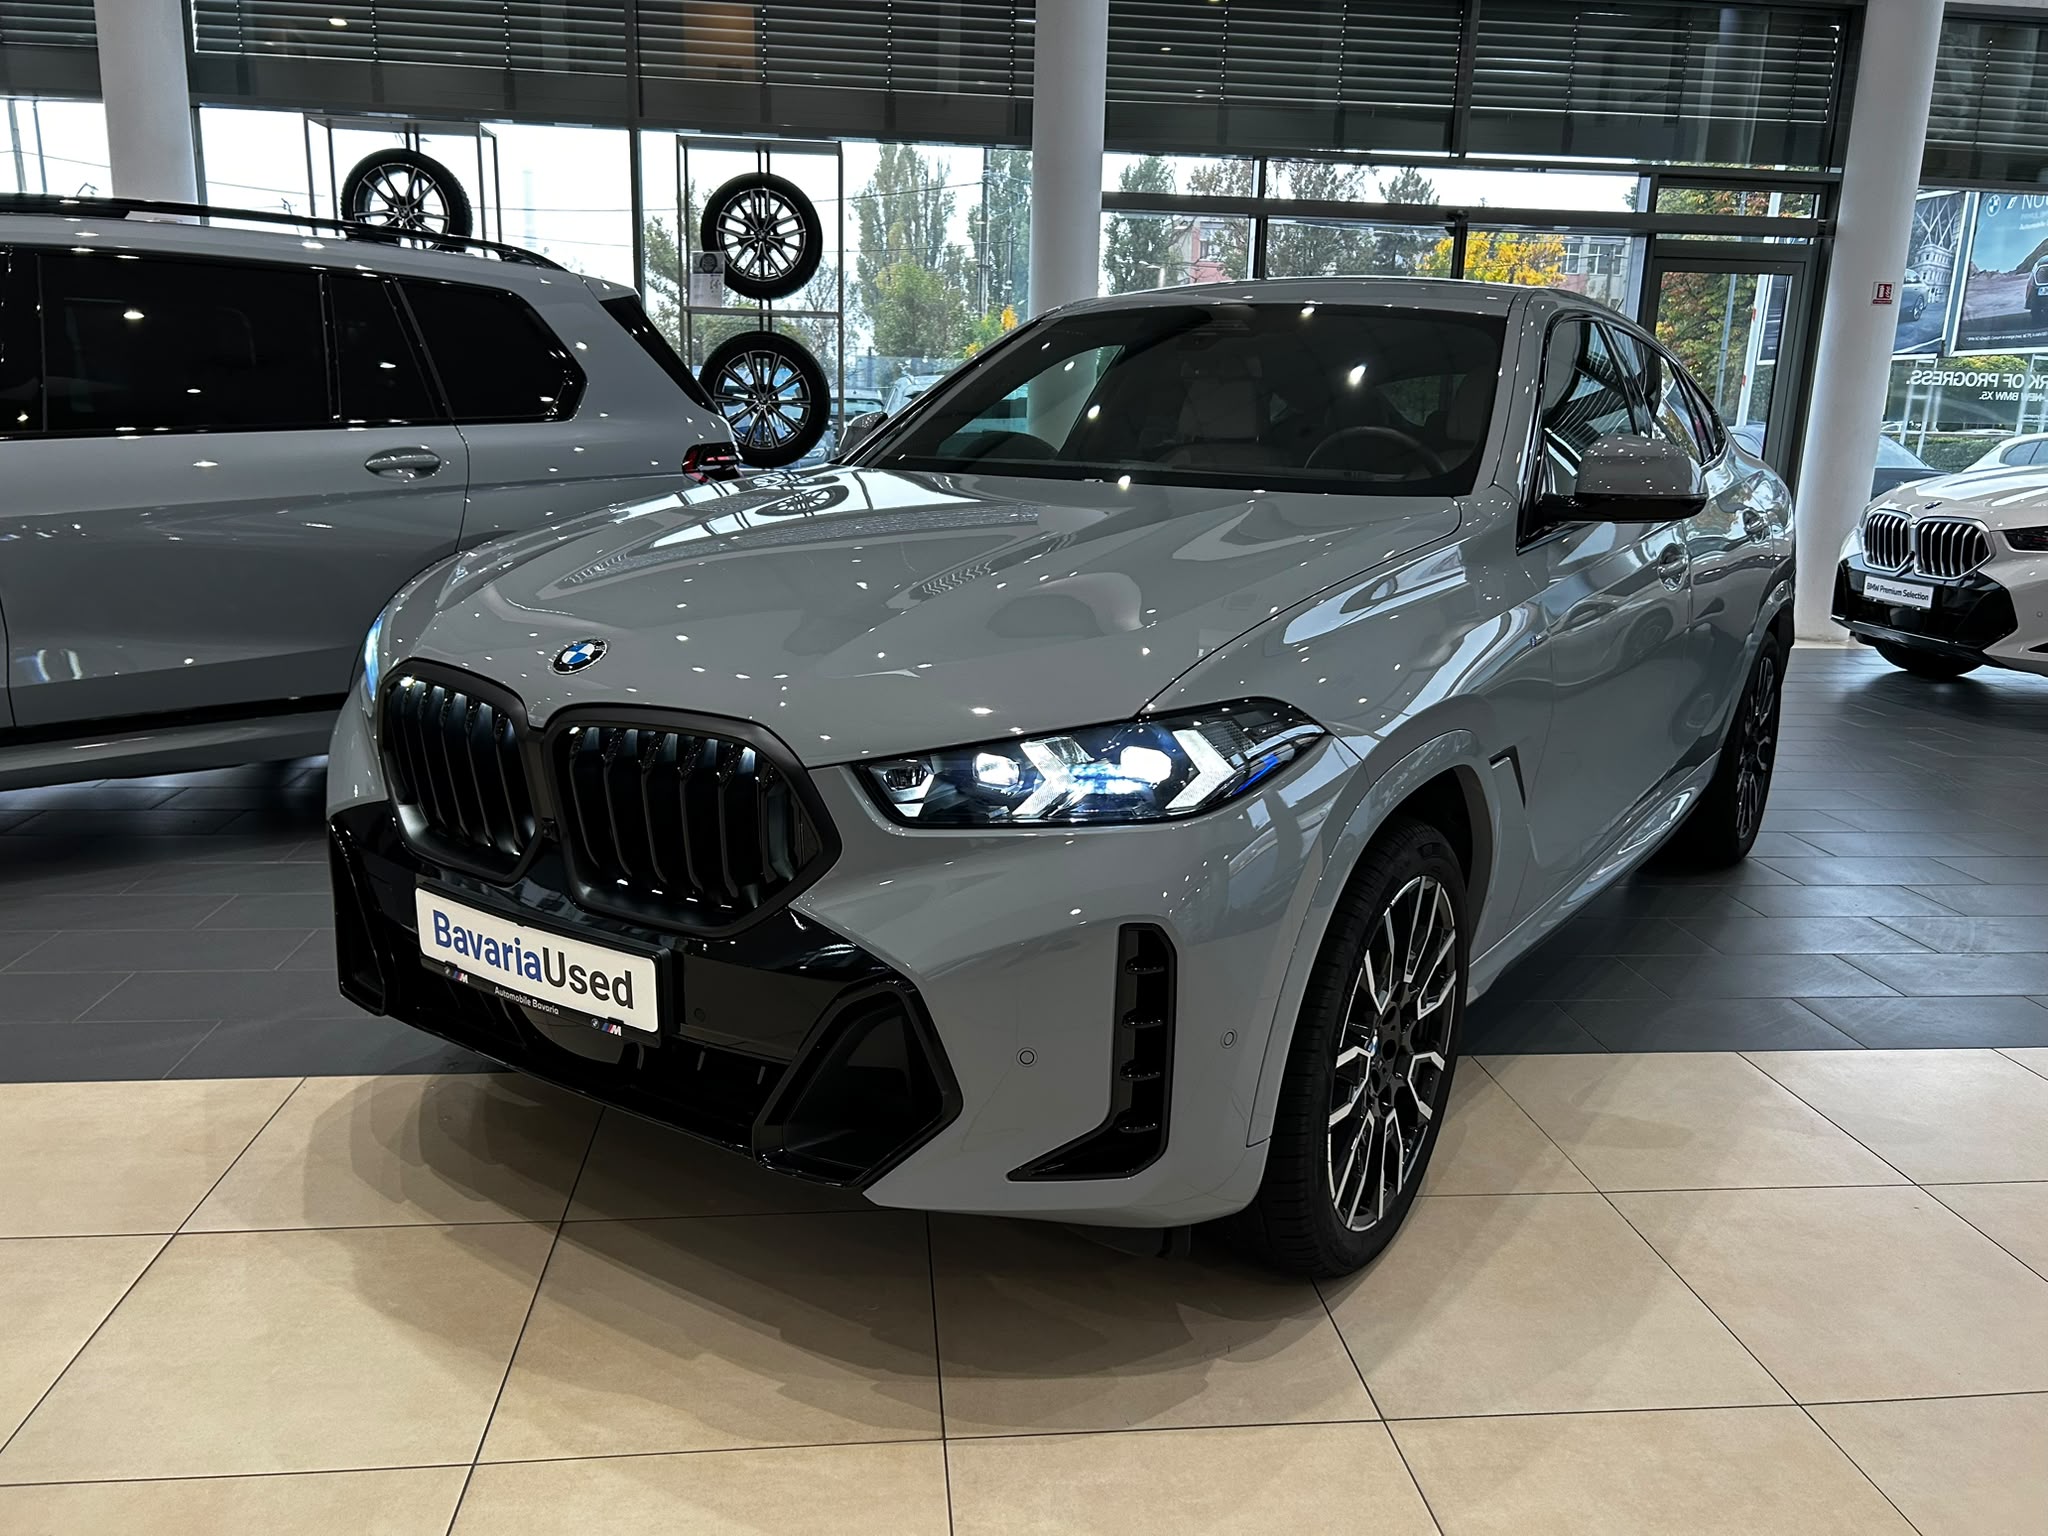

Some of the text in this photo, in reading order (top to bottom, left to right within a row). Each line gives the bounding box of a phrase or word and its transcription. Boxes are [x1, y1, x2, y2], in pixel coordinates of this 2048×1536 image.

[1866, 582, 1929, 601] BMW Premium Selection
[432, 909, 634, 1010] BavariaUsed
[494, 986, 559, 1015] Automobile Bavaria
